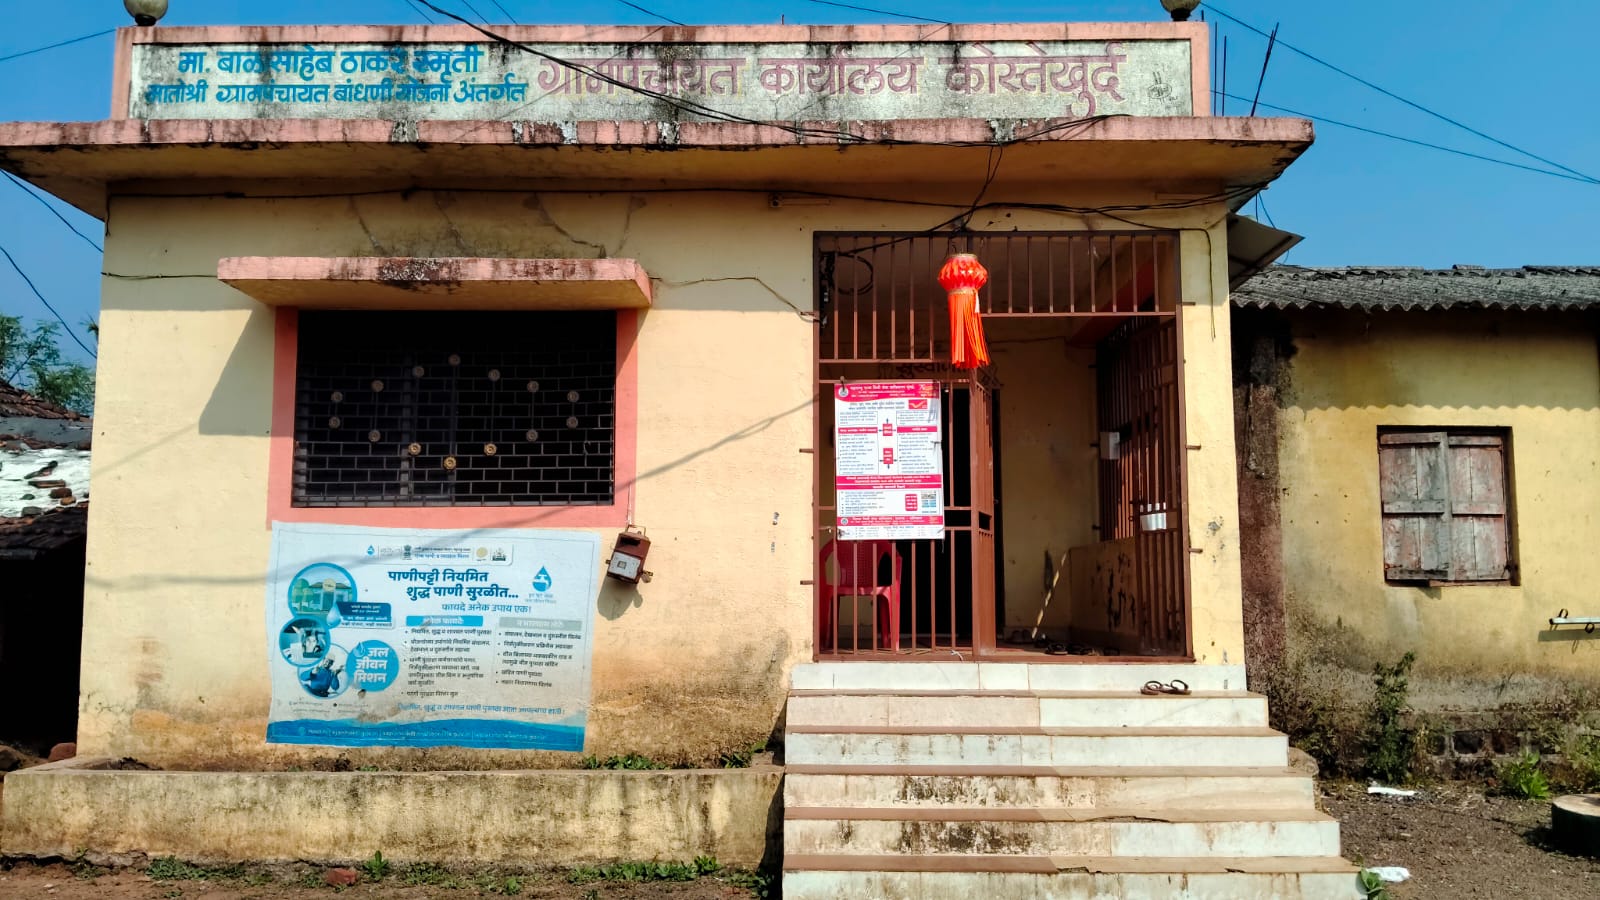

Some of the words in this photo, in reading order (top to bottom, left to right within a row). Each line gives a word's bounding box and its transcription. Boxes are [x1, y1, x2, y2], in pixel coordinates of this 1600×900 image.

[177, 51, 211, 74] मा.
[340, 44, 409, 74] ठाकरे
[536, 47, 748, 97] ग्रामपंचायत
[757, 44, 926, 96] कार्यालय
[145, 79, 209, 104] मातोश्री
[215, 79, 331, 104] ग्रामपंचायत
[333, 78, 395, 104] बांधणी
[453, 72, 530, 104] अंतर्गत
[388, 568, 440, 586] पाणीपट्टी
[442, 568, 489, 582] नियमित
[406, 586, 432, 601] शुद्ध
[433, 583, 464, 597] पाणी
[466, 583, 519, 601] सुरळीत...
[441, 602, 466, 612] फायदे
[467, 602, 490, 612] अनेक
[491, 604, 513, 612] उपाय
[367, 647, 390, 658] जल
[355, 656, 388, 669] जीवन
[354, 669, 388, 683] मिशन
